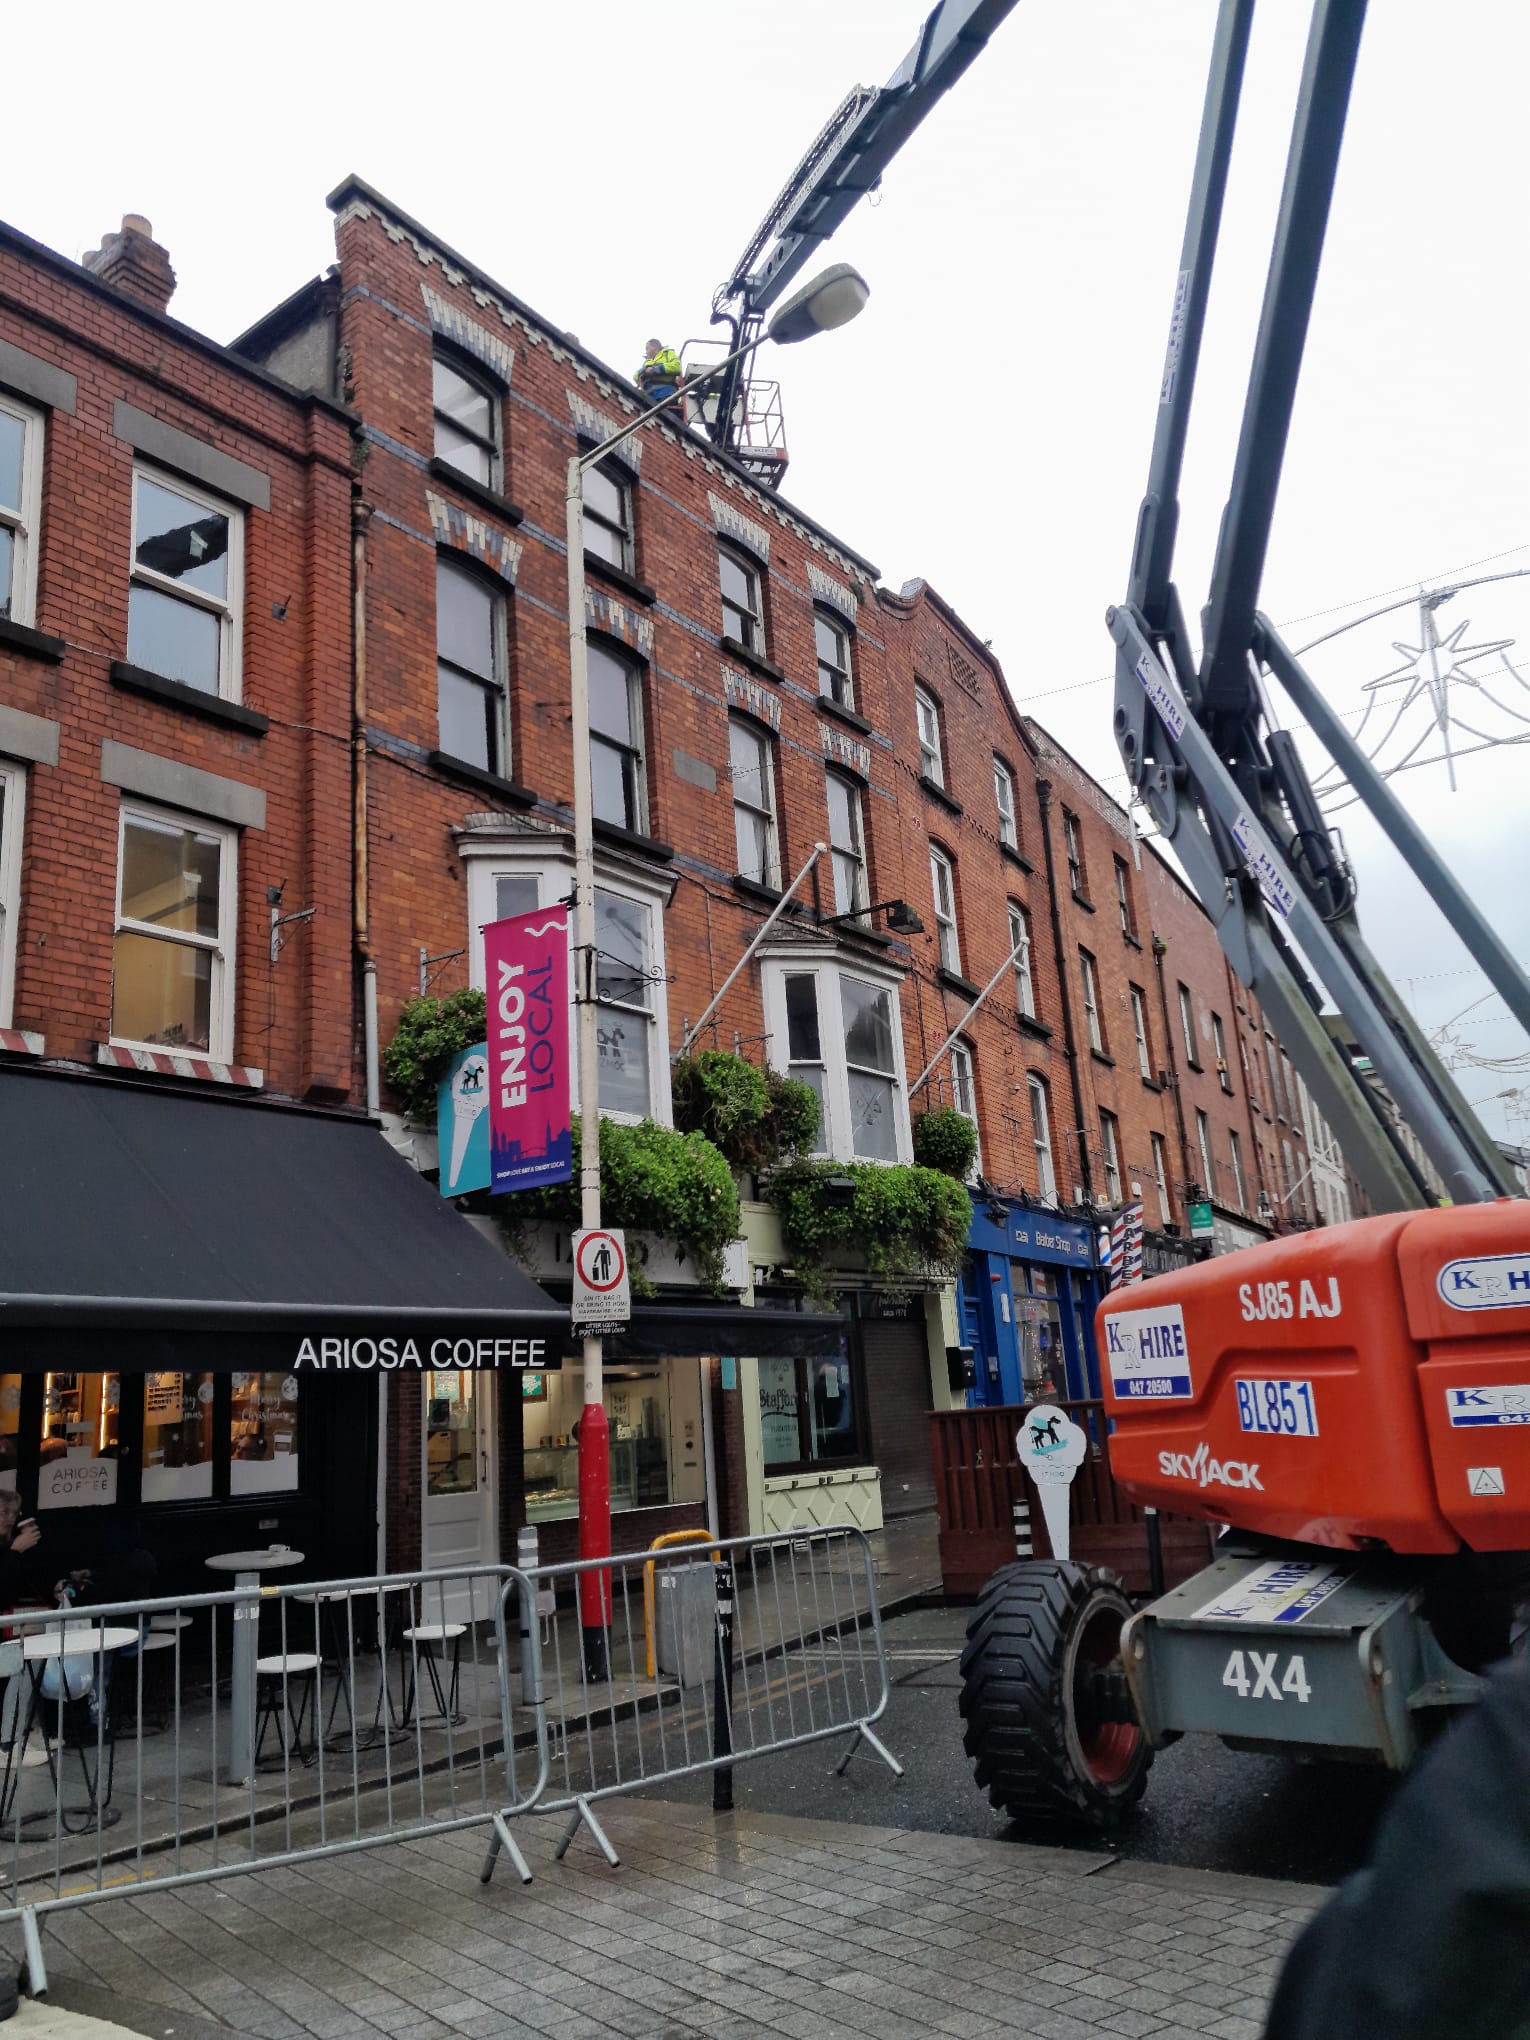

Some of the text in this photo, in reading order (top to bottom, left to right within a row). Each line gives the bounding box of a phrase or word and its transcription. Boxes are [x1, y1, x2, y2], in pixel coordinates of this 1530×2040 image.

[498, 959, 527, 1108] ENJOY
[527, 955, 554, 1093] LOCAL
[1239, 1276, 1342, 1322] SJ85 AJ
[293, 1338, 546, 1369] ARIOSA COFFEE
[1138, 1323, 1185, 1359] HIRE
[1129, 1379, 1173, 1395] 047 20500
[1236, 1381, 1315, 1436] BL851
[1158, 1441, 1265, 1491] SKYJACK
[1248, 1562, 1317, 1595] HIRE
[1222, 1649, 1312, 1703] 4X4
